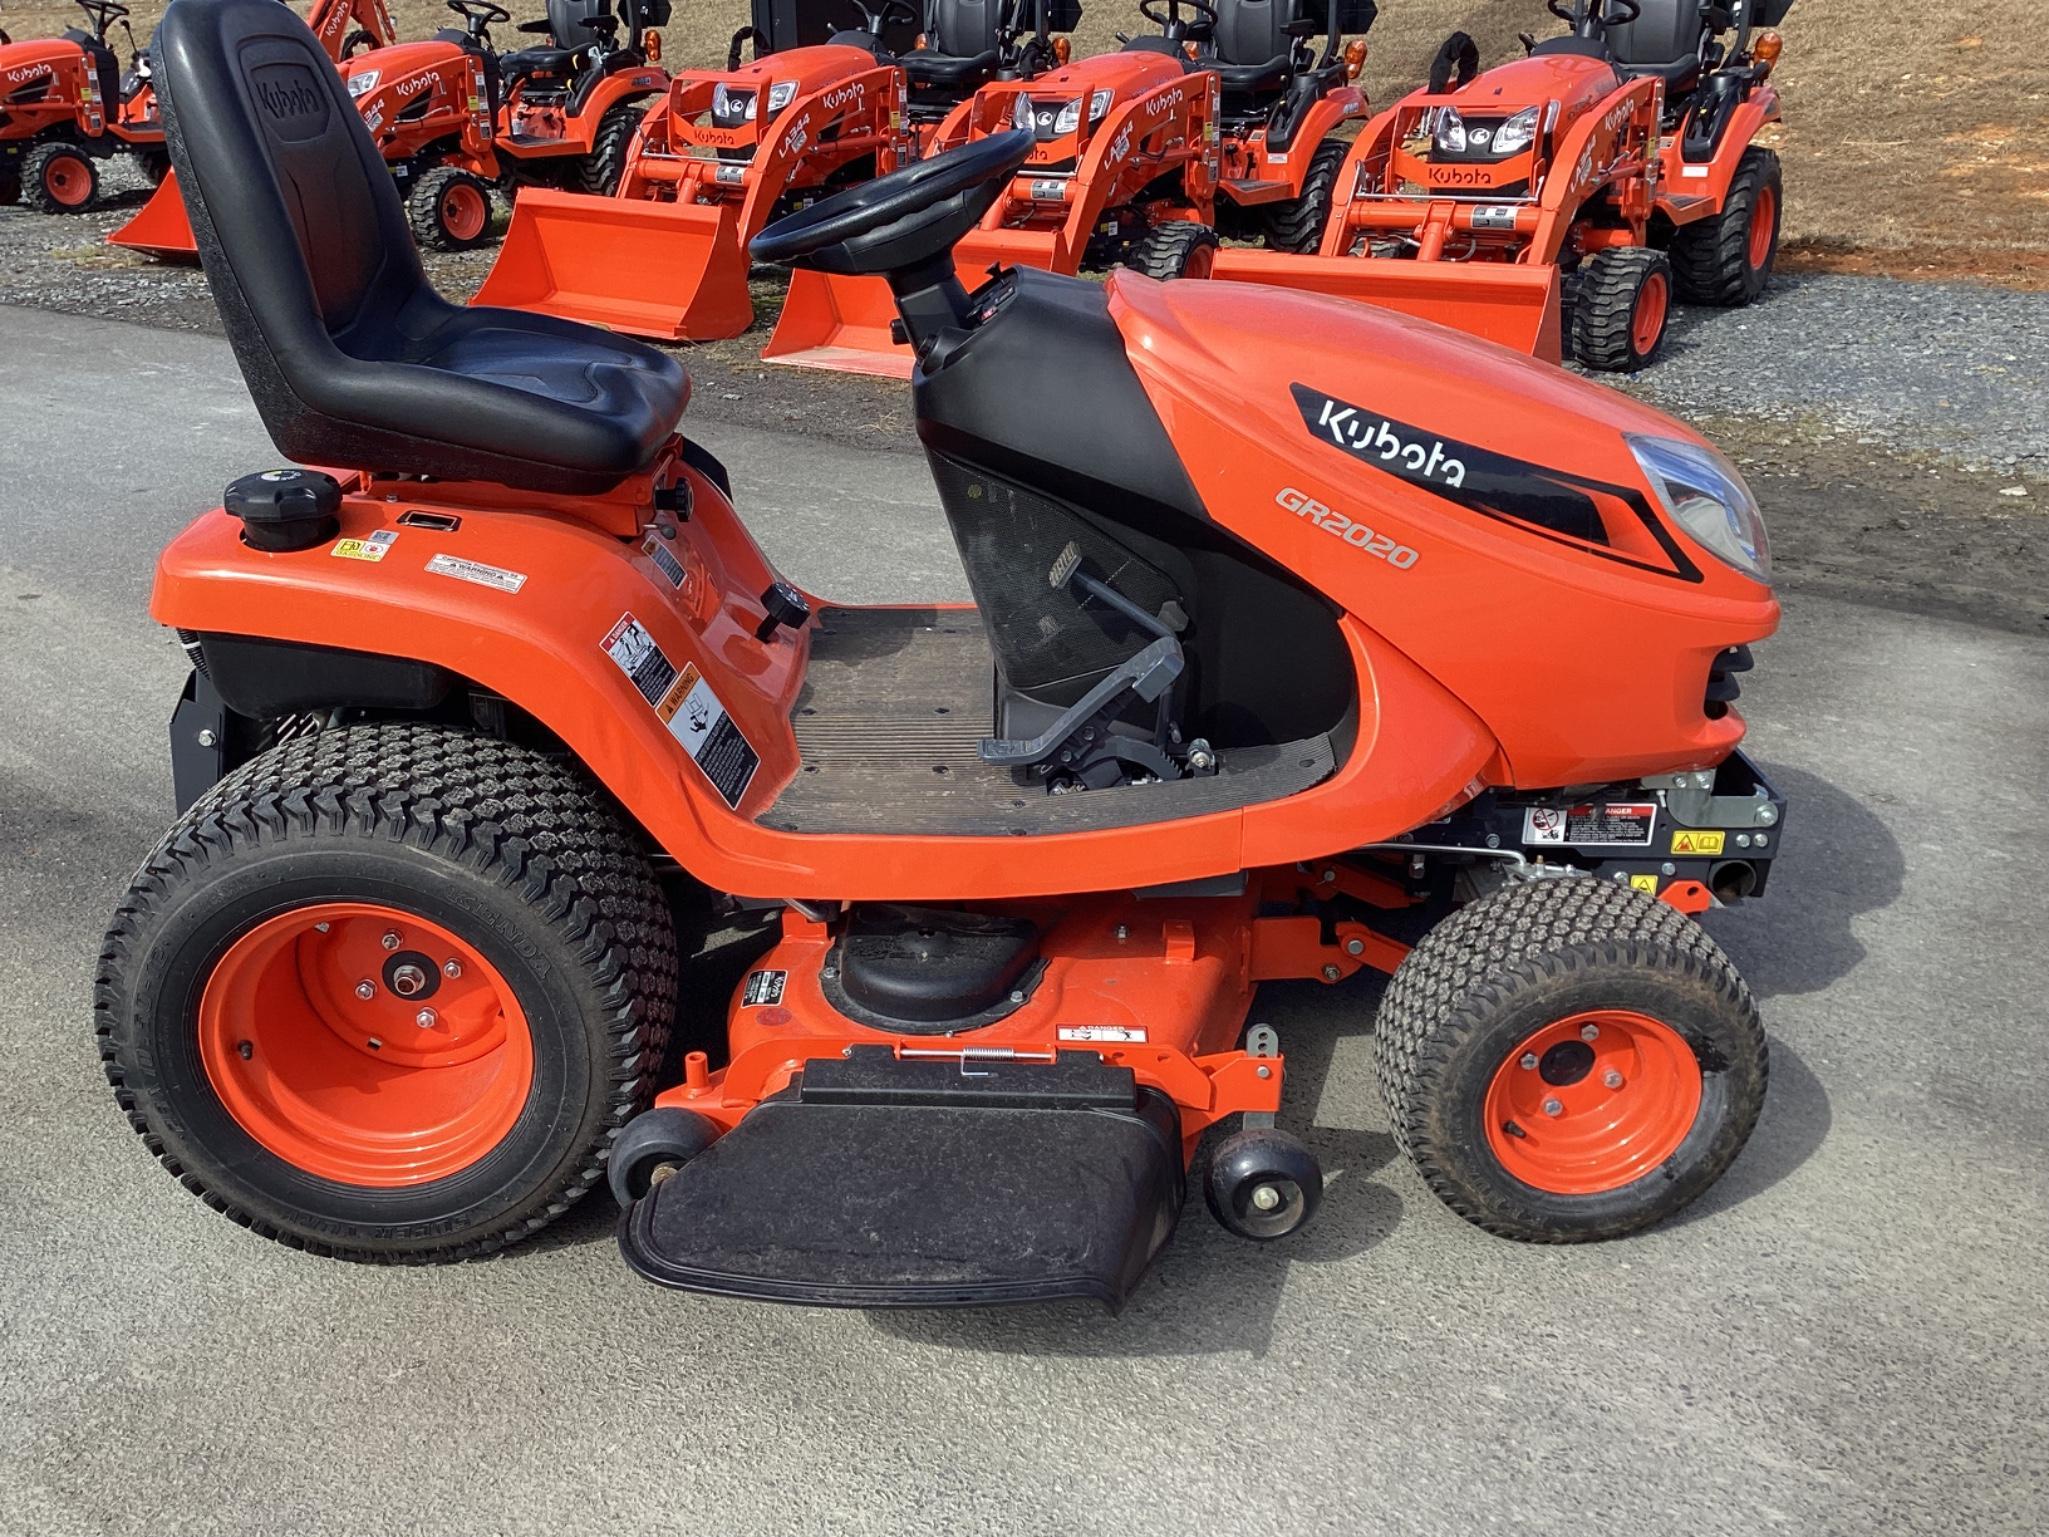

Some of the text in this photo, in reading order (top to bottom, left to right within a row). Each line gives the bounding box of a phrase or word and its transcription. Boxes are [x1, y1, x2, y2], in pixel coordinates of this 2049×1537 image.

[325, 1, 348, 37] Kubota
[7, 63, 52, 82] Kubota
[396, 71, 440, 96] Kubota
[256, 79, 320, 119] Kubota
[363, 98, 385, 122] 344
[823, 82, 865, 109] Kubota
[1145, 87, 1183, 116] Kubota
[1604, 98, 1634, 131] Kubota
[694, 130, 734, 145] Kubota
[779, 112, 811, 159] LA344
[1428, 167, 1492, 185] Kubota
[1318, 399, 1466, 489] Kubota
[1275, 487, 1420, 570] GR2020
[672, 672, 695, 706] WARNING
[445, 883, 552, 980] KENDA
